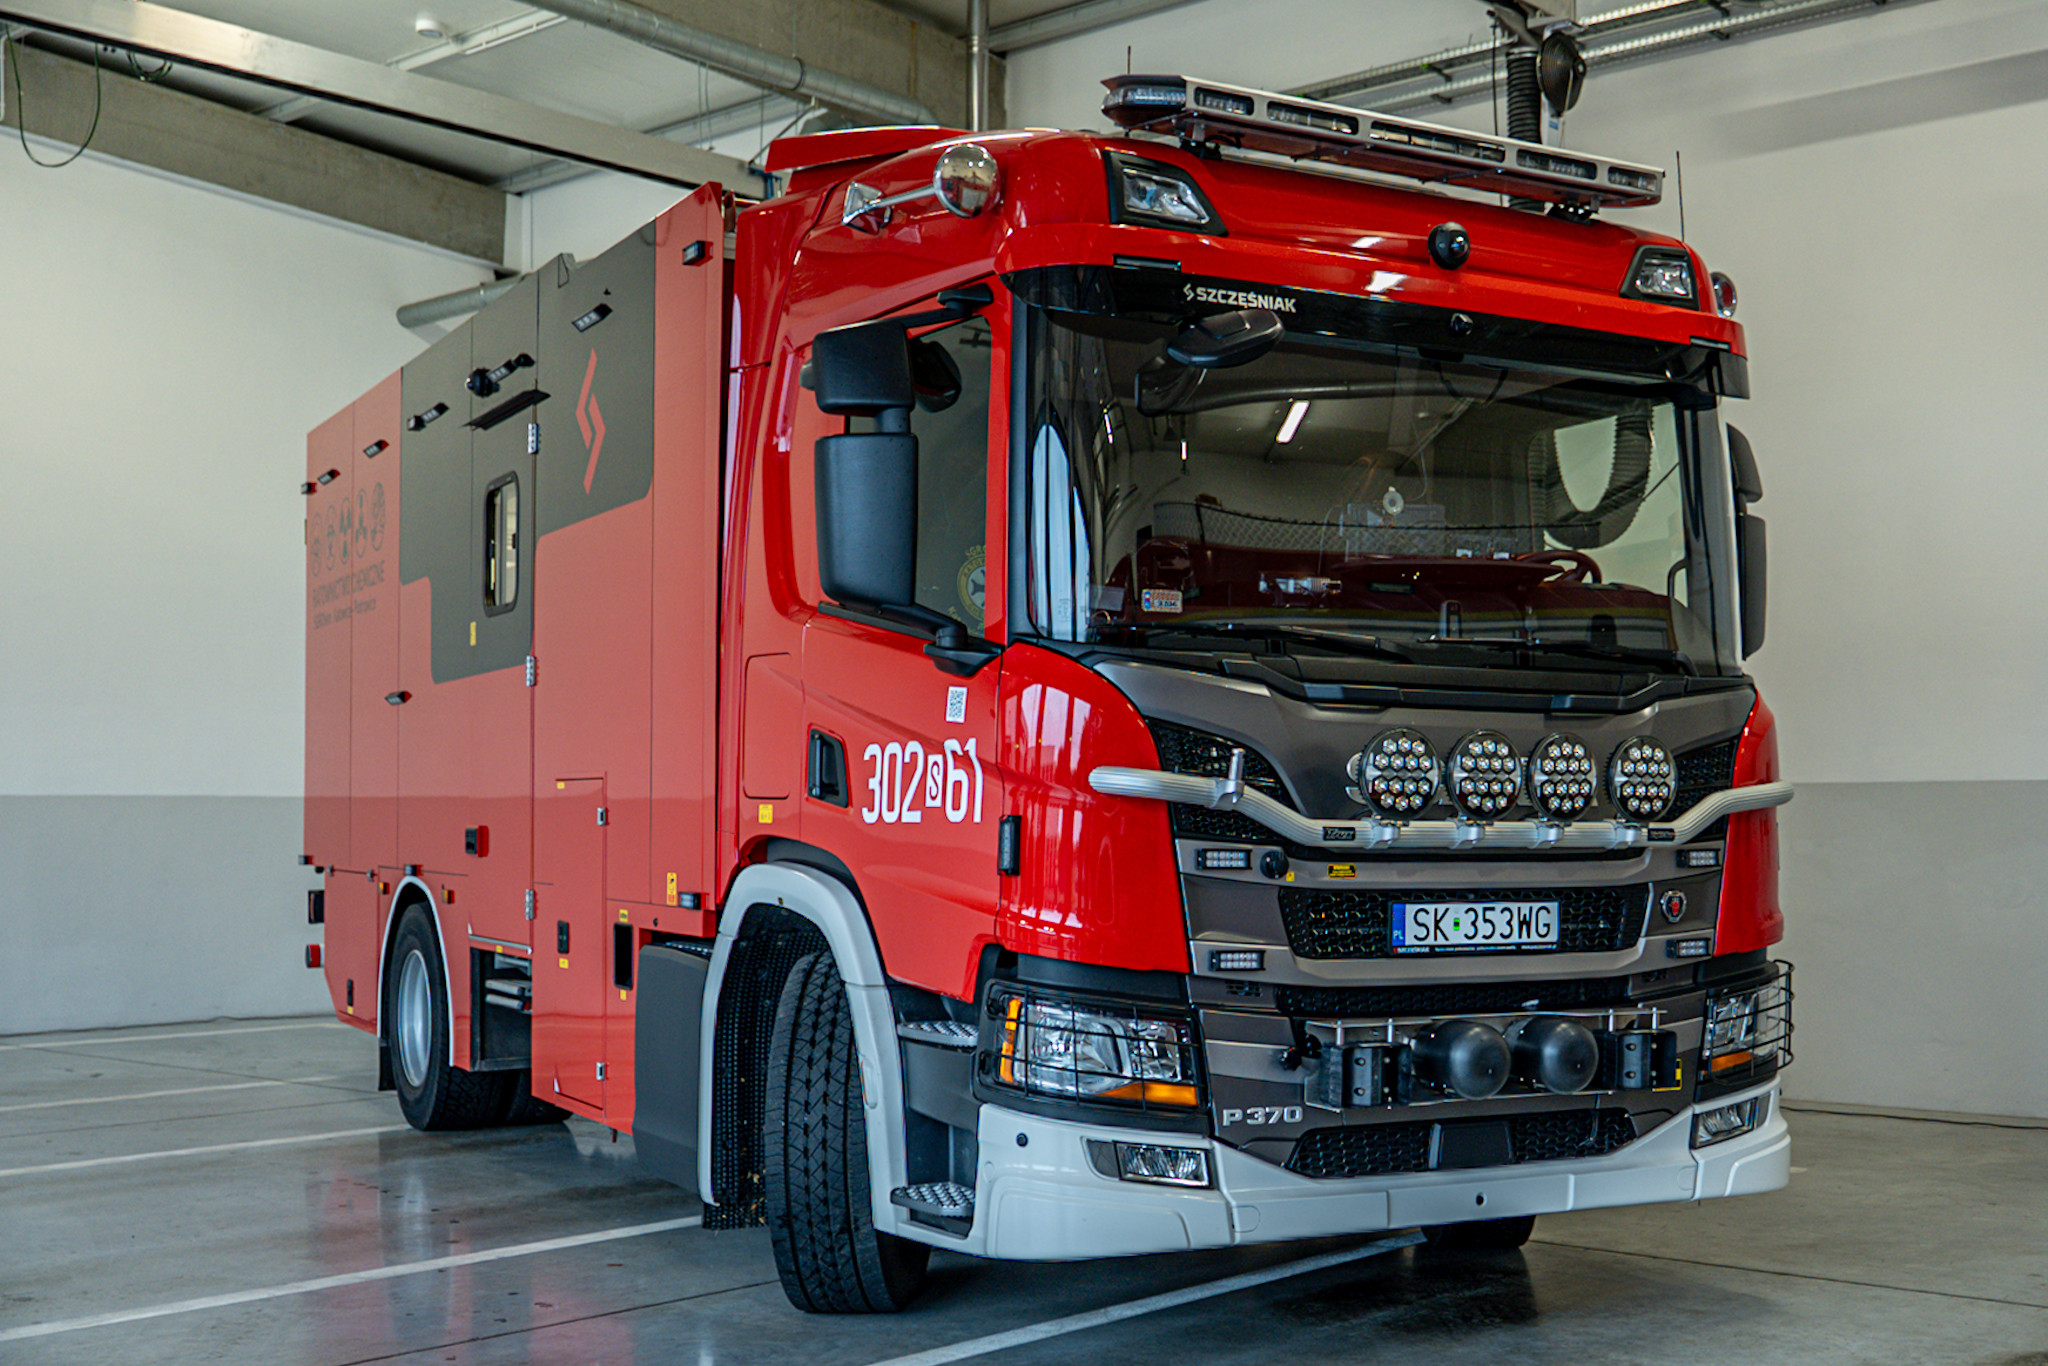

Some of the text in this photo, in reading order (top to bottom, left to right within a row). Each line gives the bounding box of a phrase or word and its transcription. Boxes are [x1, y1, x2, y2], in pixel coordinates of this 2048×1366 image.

[1195, 286, 1297, 314] SZCZĘŚNIAK
[1392, 930, 1404, 940] PL
[1412, 905, 1551, 942] SK 353WG
[1222, 1105, 1304, 1127] P 370
